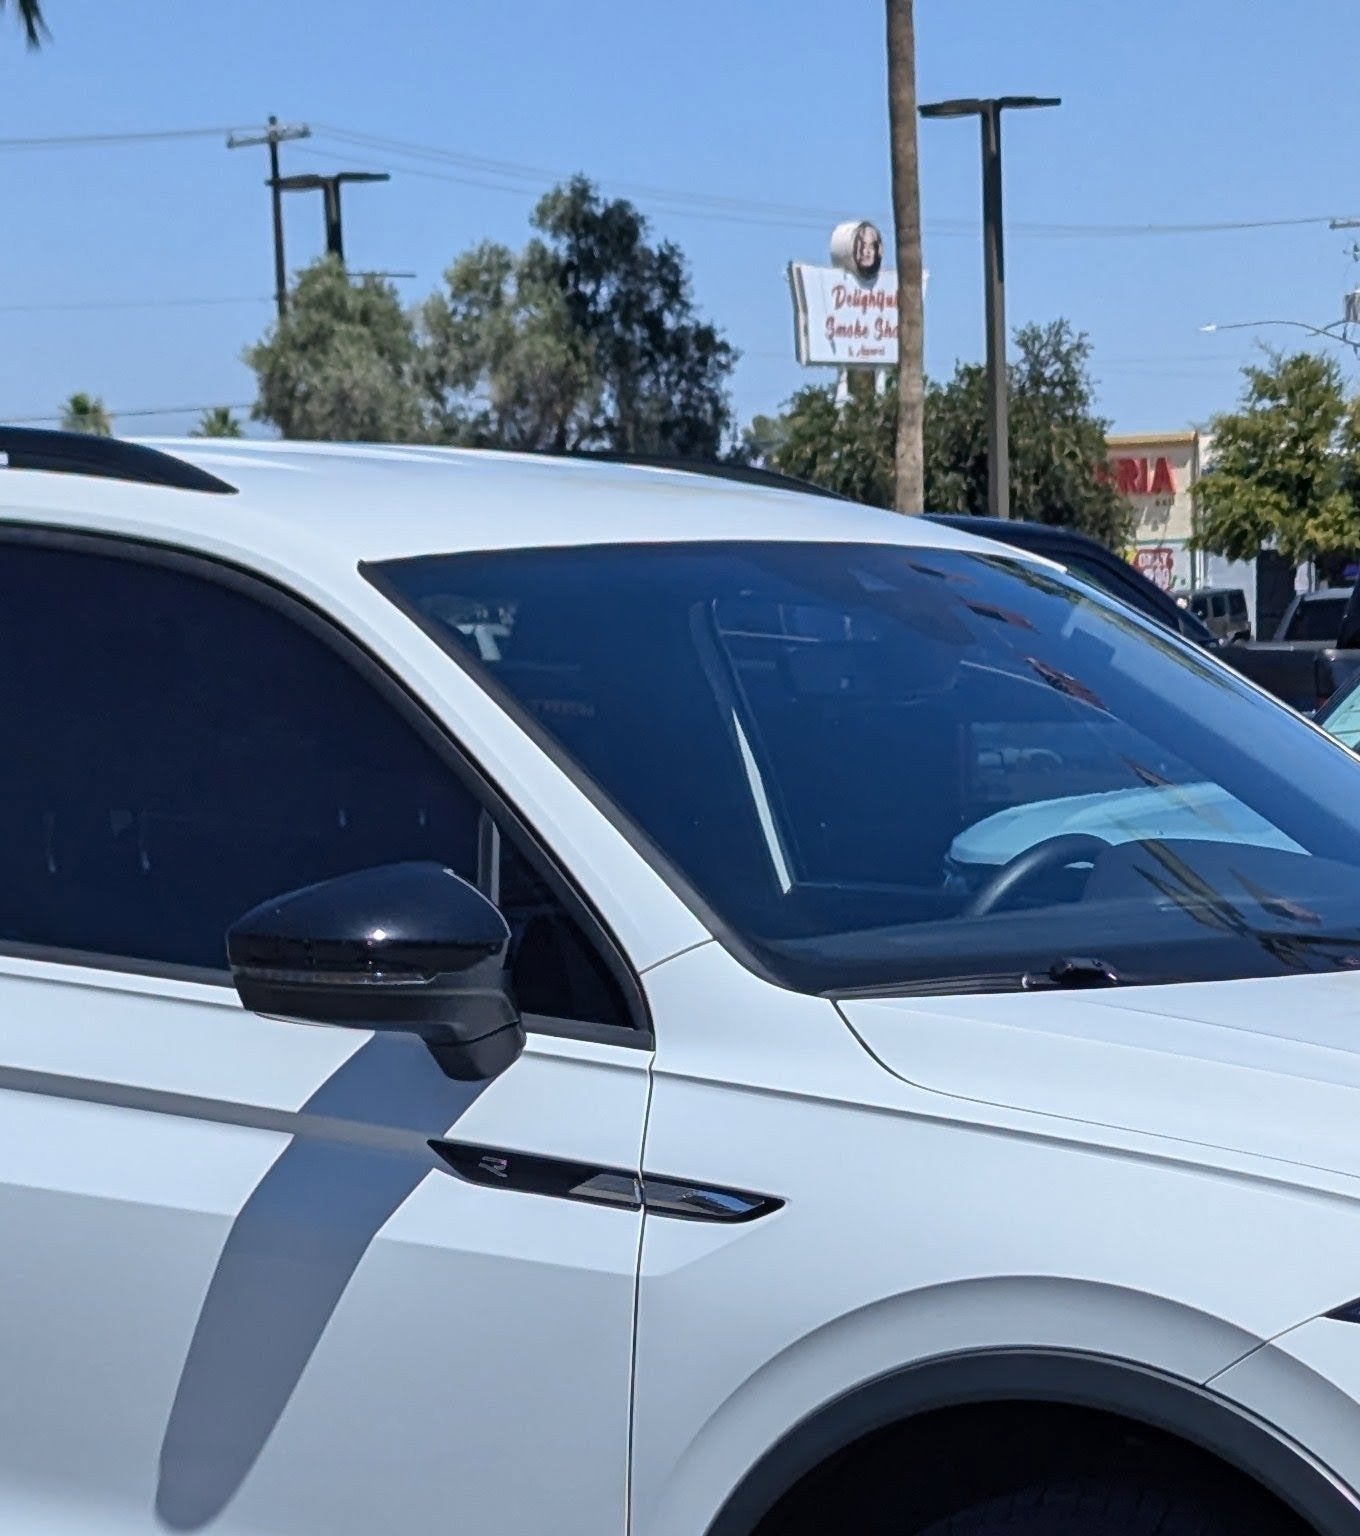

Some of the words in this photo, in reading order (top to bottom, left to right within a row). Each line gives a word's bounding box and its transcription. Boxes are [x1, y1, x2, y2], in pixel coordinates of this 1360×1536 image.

[826, 316, 869, 340] Smoke
[874, 317, 900, 341] Sho
[1095, 456, 1175, 494] RIA
